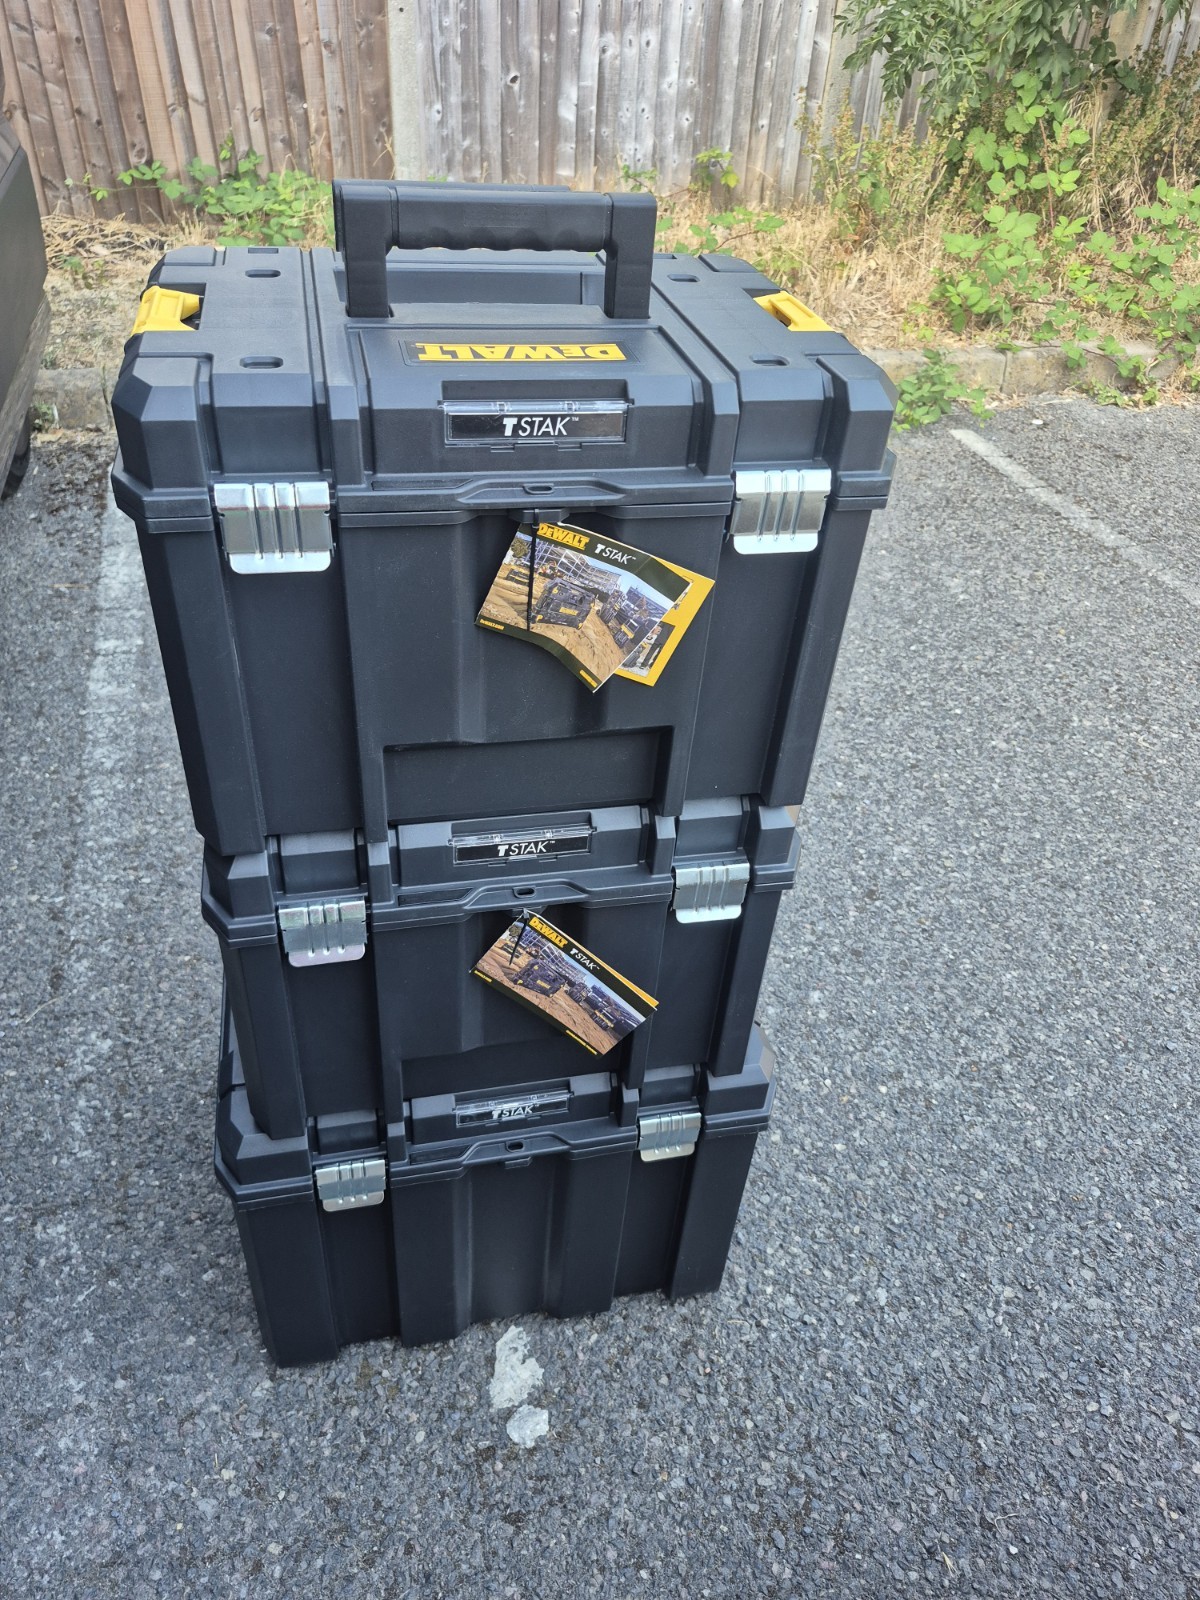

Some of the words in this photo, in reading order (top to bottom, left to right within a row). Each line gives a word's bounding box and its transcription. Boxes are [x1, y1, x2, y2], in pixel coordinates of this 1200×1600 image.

[415, 342, 627, 361] DEWALT
[536, 522, 590, 550] DEWALT
[528, 916, 569, 949] DEWALT
